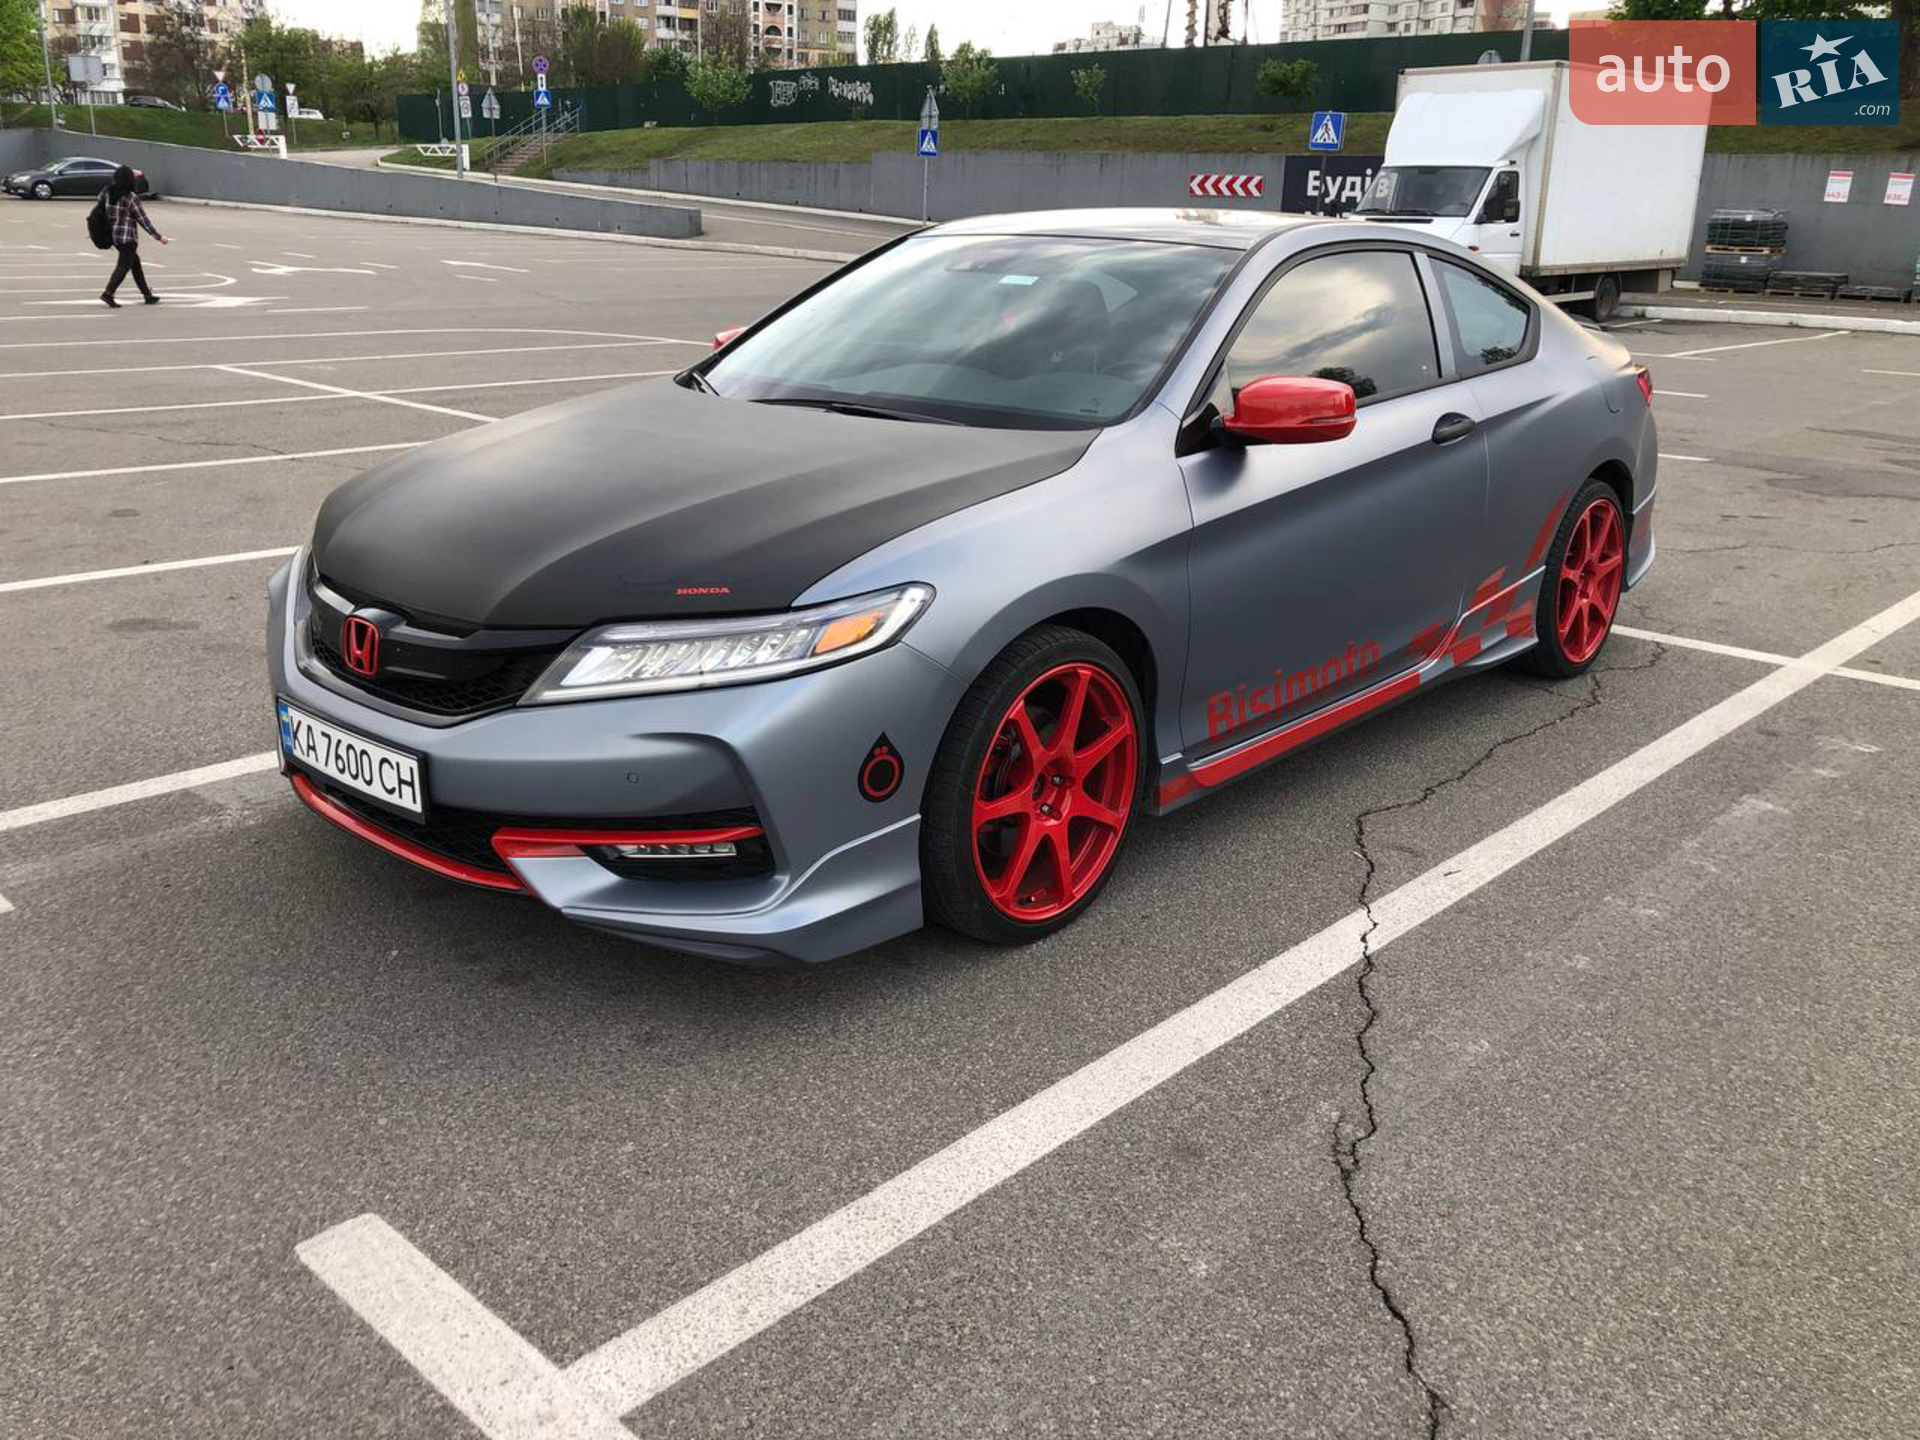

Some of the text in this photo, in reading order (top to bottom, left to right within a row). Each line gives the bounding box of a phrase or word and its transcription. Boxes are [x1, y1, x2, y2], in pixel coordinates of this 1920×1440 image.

[675, 586, 732, 596] HONDA
[290, 715, 417, 805] KA 7600 CH
